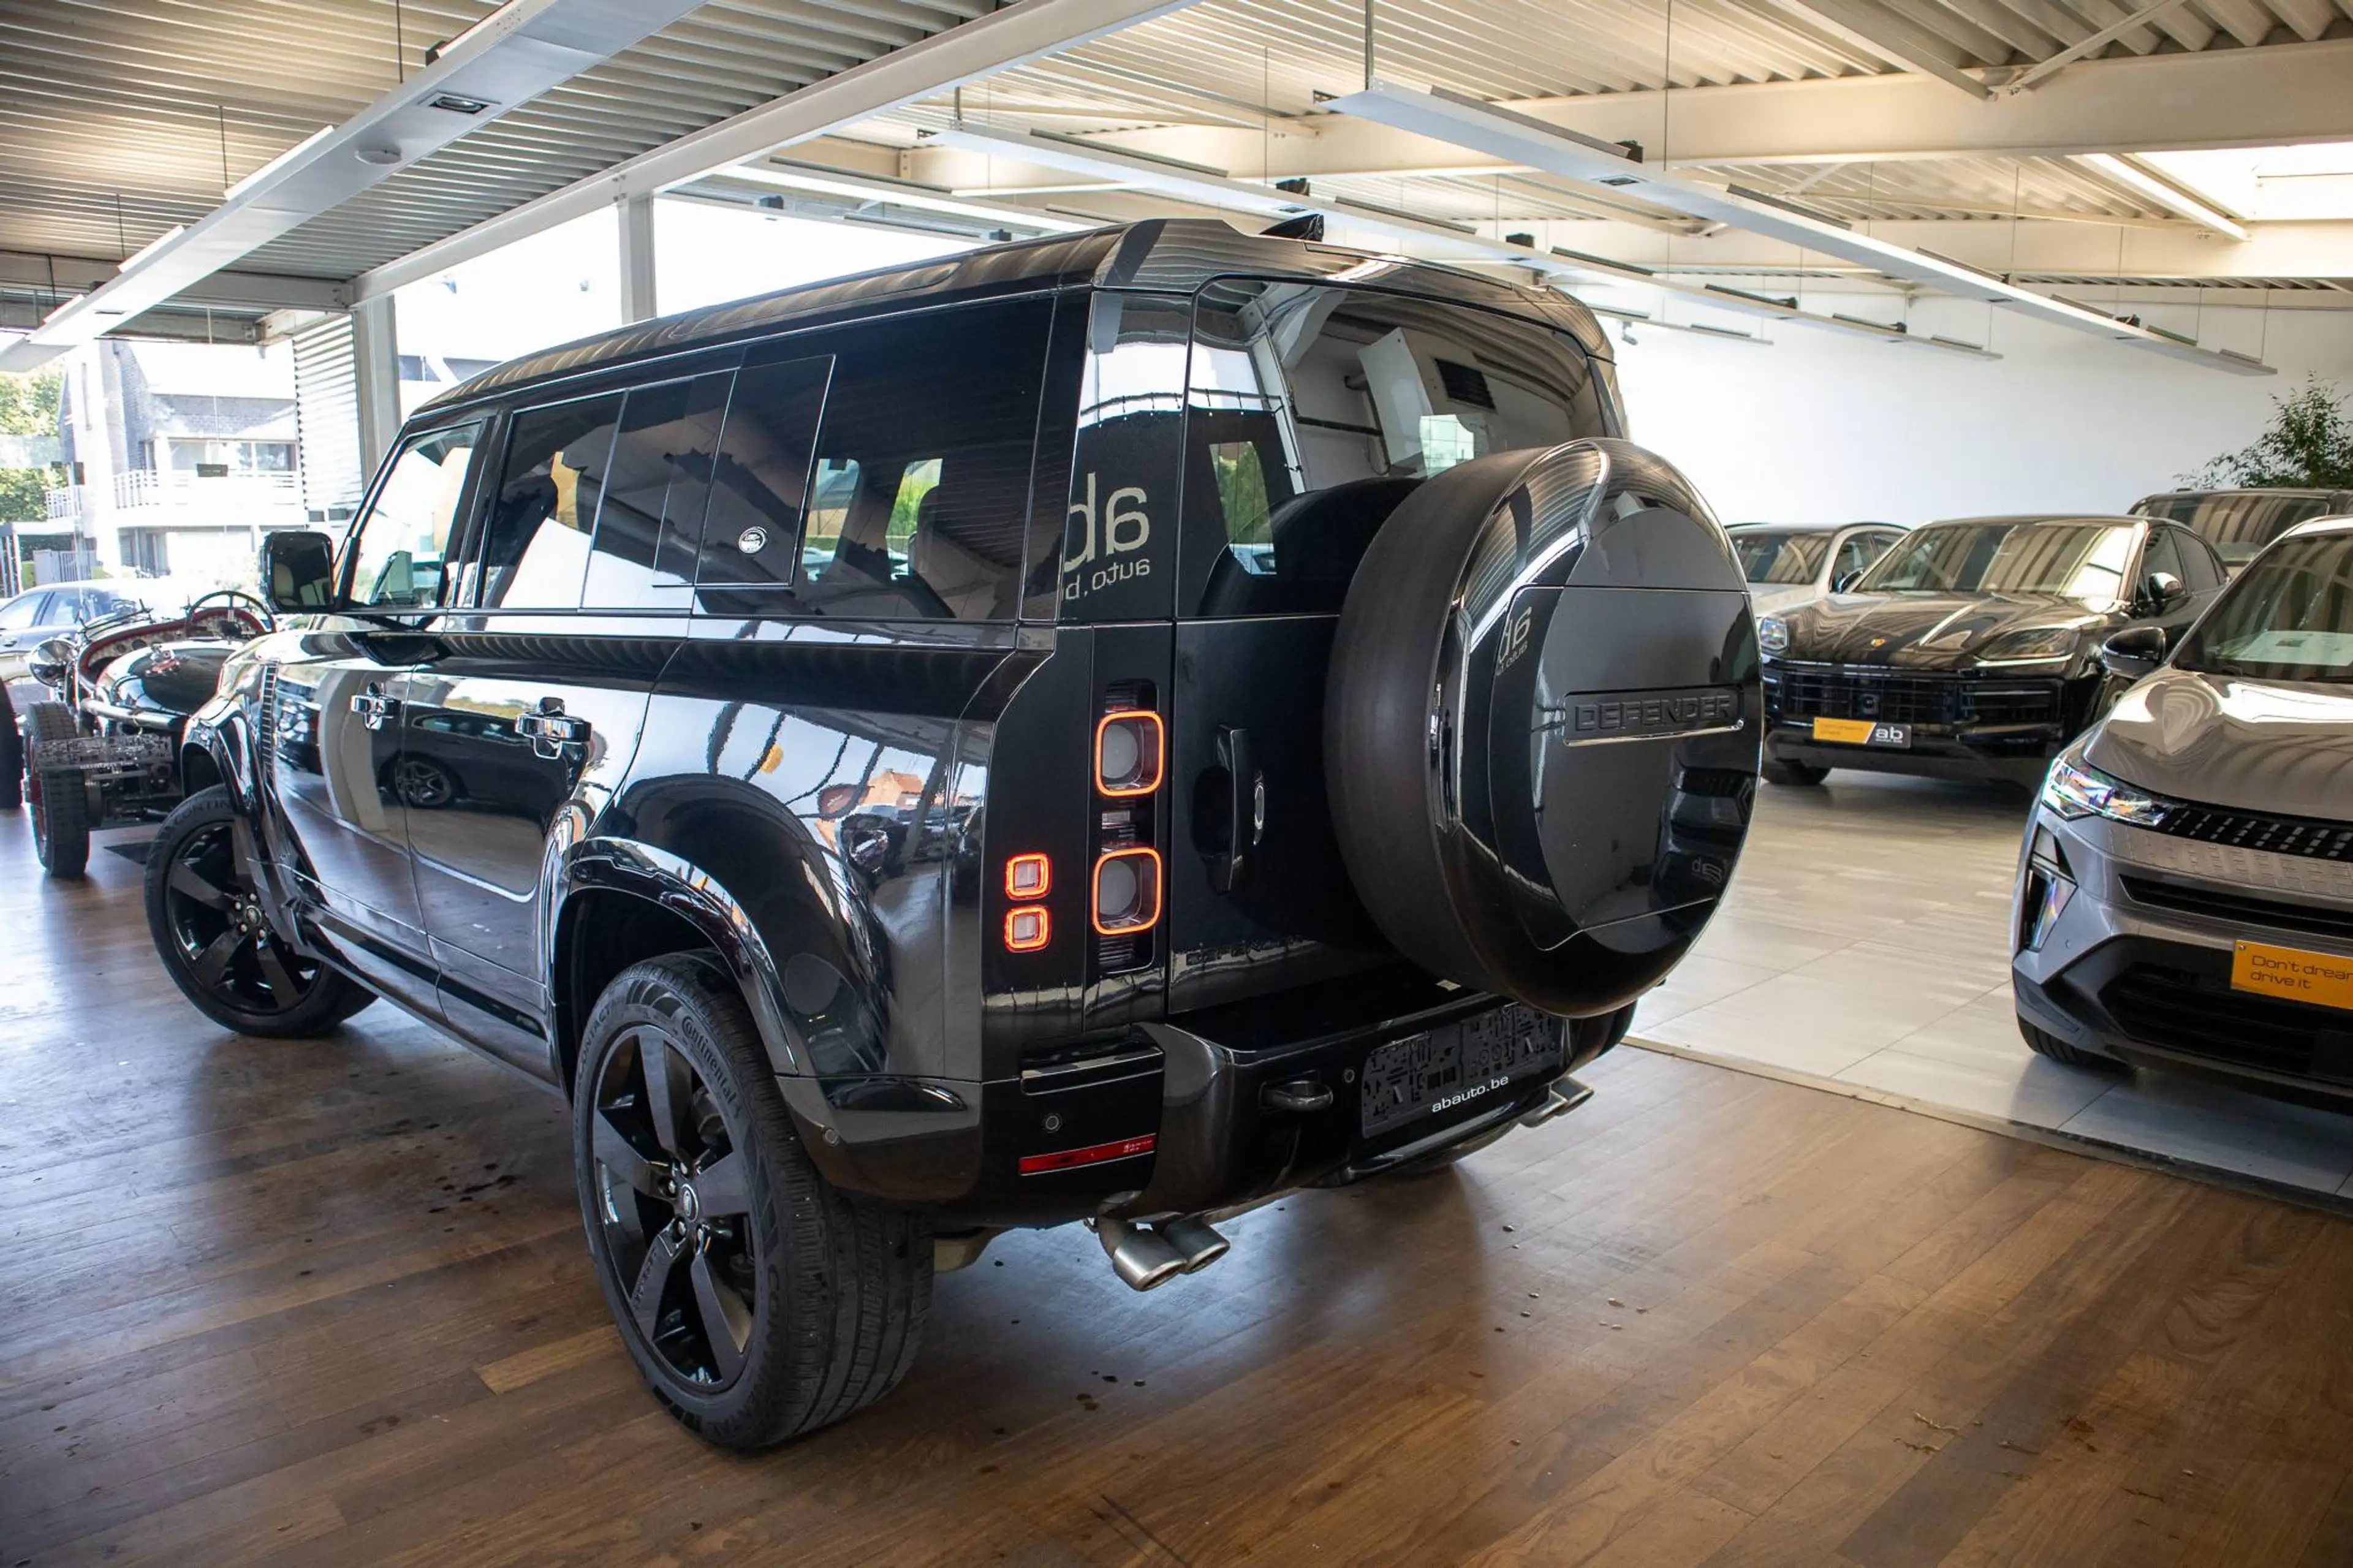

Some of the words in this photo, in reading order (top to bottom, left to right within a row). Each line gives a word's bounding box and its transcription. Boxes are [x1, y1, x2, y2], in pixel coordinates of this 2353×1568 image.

[1574, 694, 1732, 732] DEFENDER
[1874, 726, 1904, 740] ab
[2251, 955, 2300, 973] Don't
[2249, 971, 2295, 987] drive
[2298, 979, 2312, 990] it
[681, 1015, 738, 1104] Continental
[1432, 1075, 1509, 1113] abauto.be
